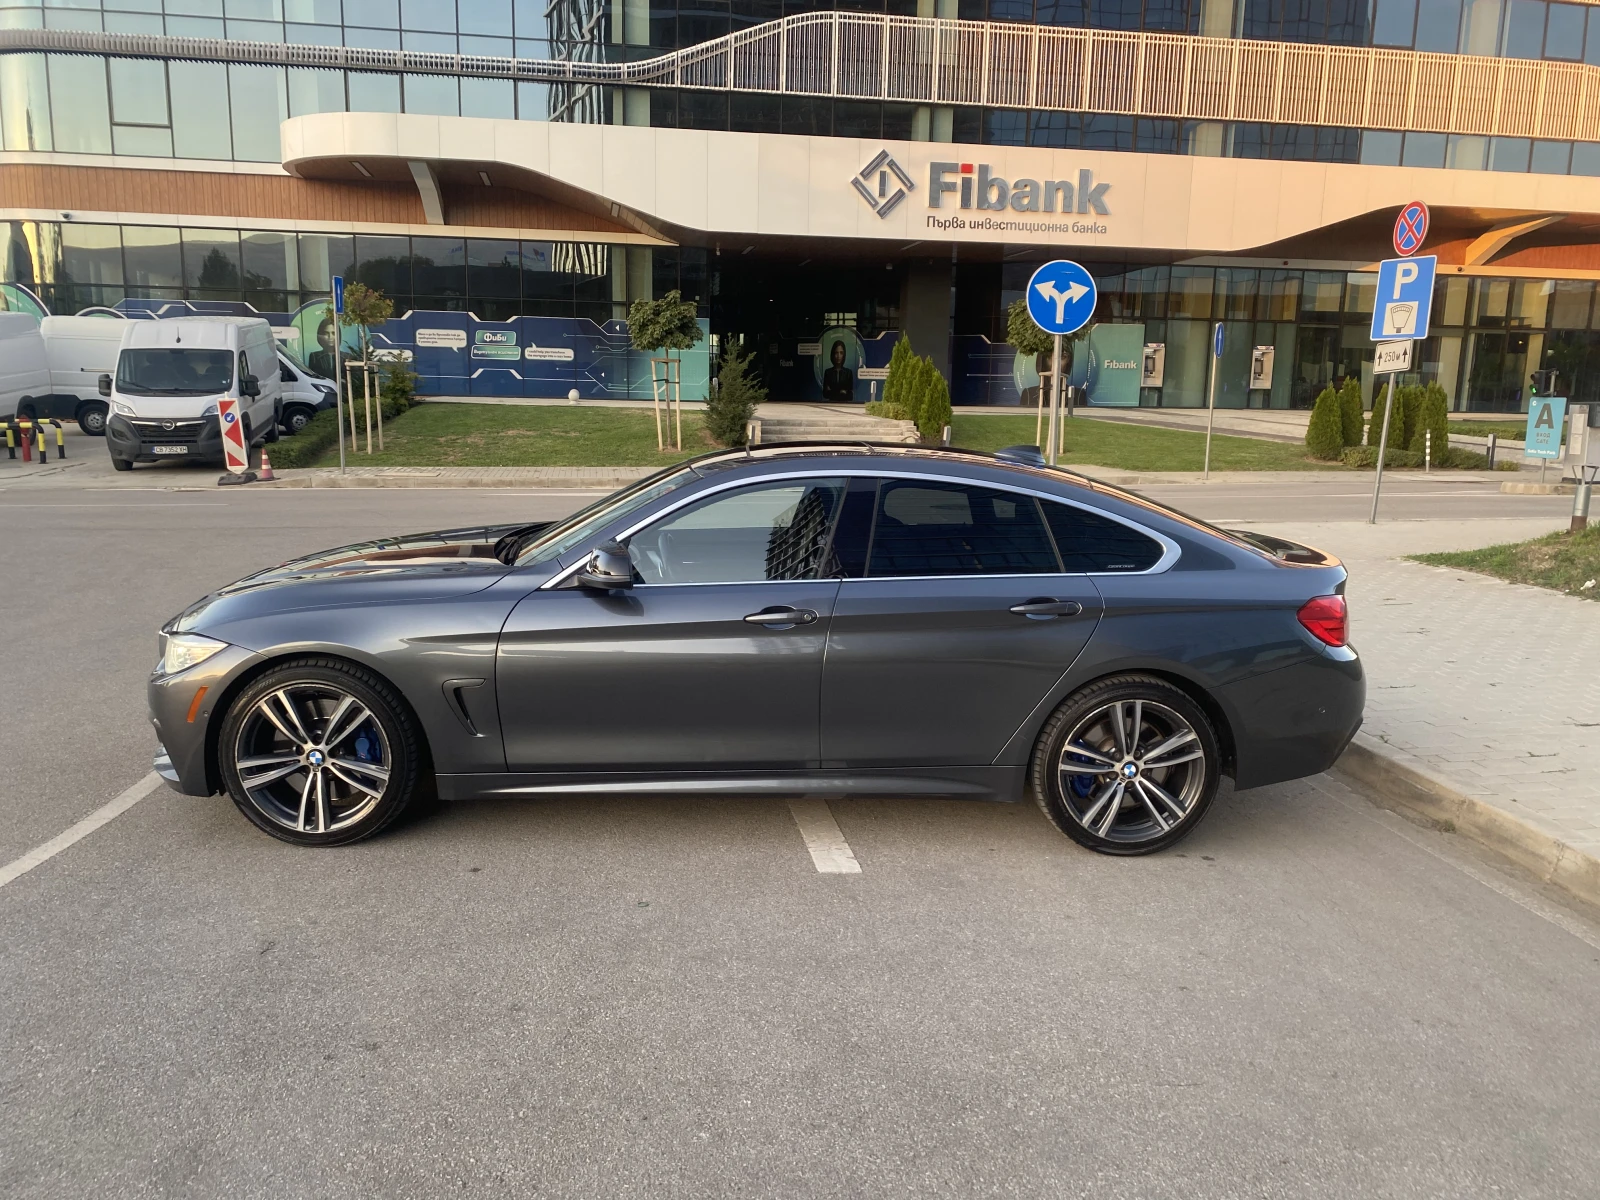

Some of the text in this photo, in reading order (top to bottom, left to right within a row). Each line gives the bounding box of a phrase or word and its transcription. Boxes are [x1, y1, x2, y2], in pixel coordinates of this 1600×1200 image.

[928, 161, 1112, 215] Fibank
[926, 215, 1107, 234] Първа инвестиционна банка
[1393, 262, 1418, 300] P
[1104, 359, 1137, 369] Fibank
[1535, 403, 1554, 429] A
